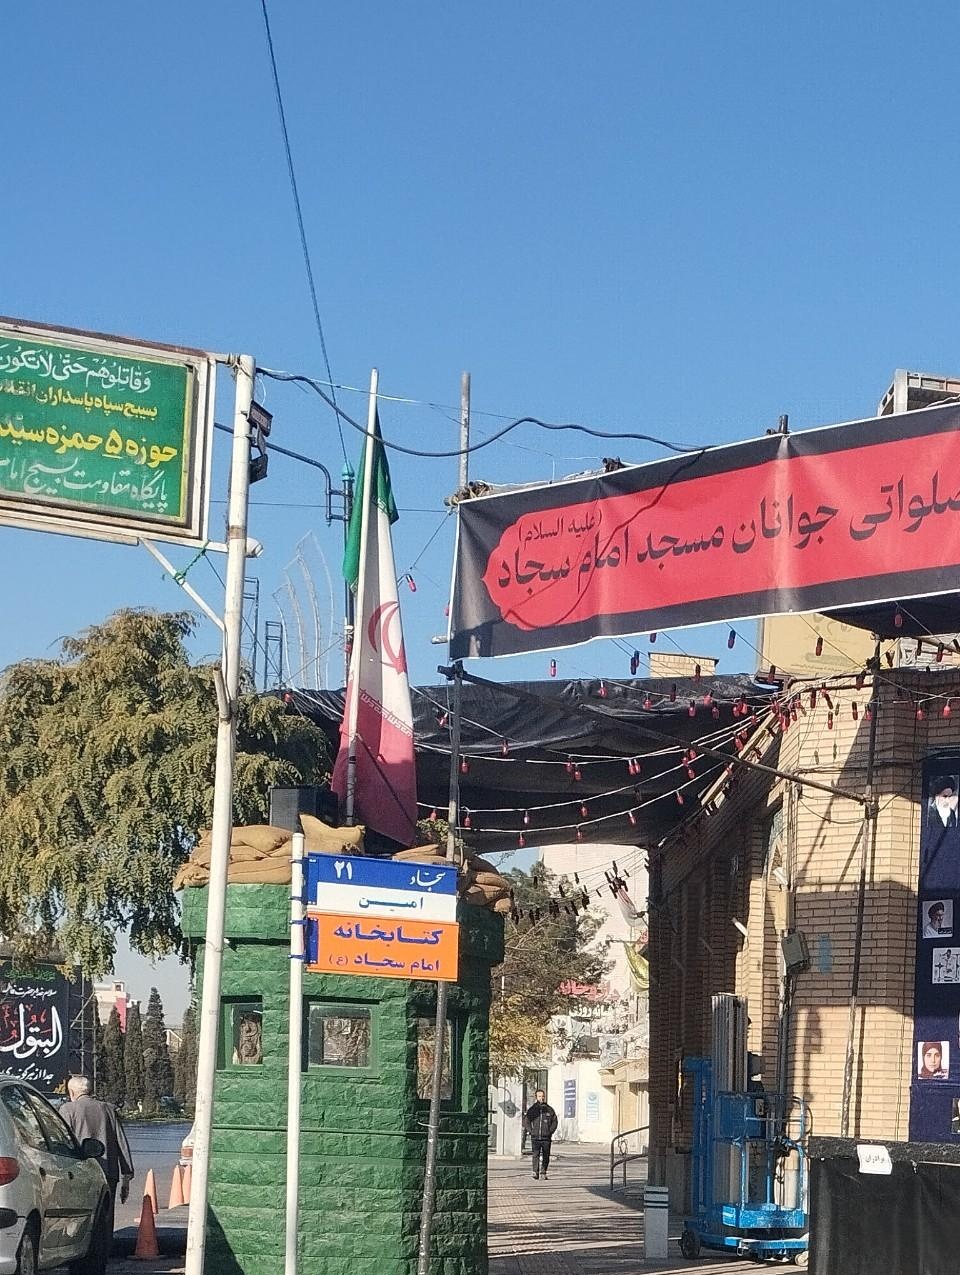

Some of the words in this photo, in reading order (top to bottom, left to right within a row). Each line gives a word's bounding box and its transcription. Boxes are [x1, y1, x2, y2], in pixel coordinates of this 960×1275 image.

[46, 424, 103, 454] حمزه
[103, 428, 123, 457] ۵
[125, 437, 178, 468] حوزه
[63, 469, 131, 496] مقاومت
[130, 470, 169, 513] پایگاه
[732, 492, 840, 554] جوانان
[577, 525, 630, 595] امام
[637, 525, 725, 570] مسجد
[498, 546, 571, 595] سجاد
[333, 860, 353, 880] ۲۱
[410, 869, 446, 892] سجاد
[358, 896, 424, 912] امین
[333, 922, 444, 947] کتابخانه
[354, 952, 405, 971] سجاد
[410, 957, 440, 974] امام
